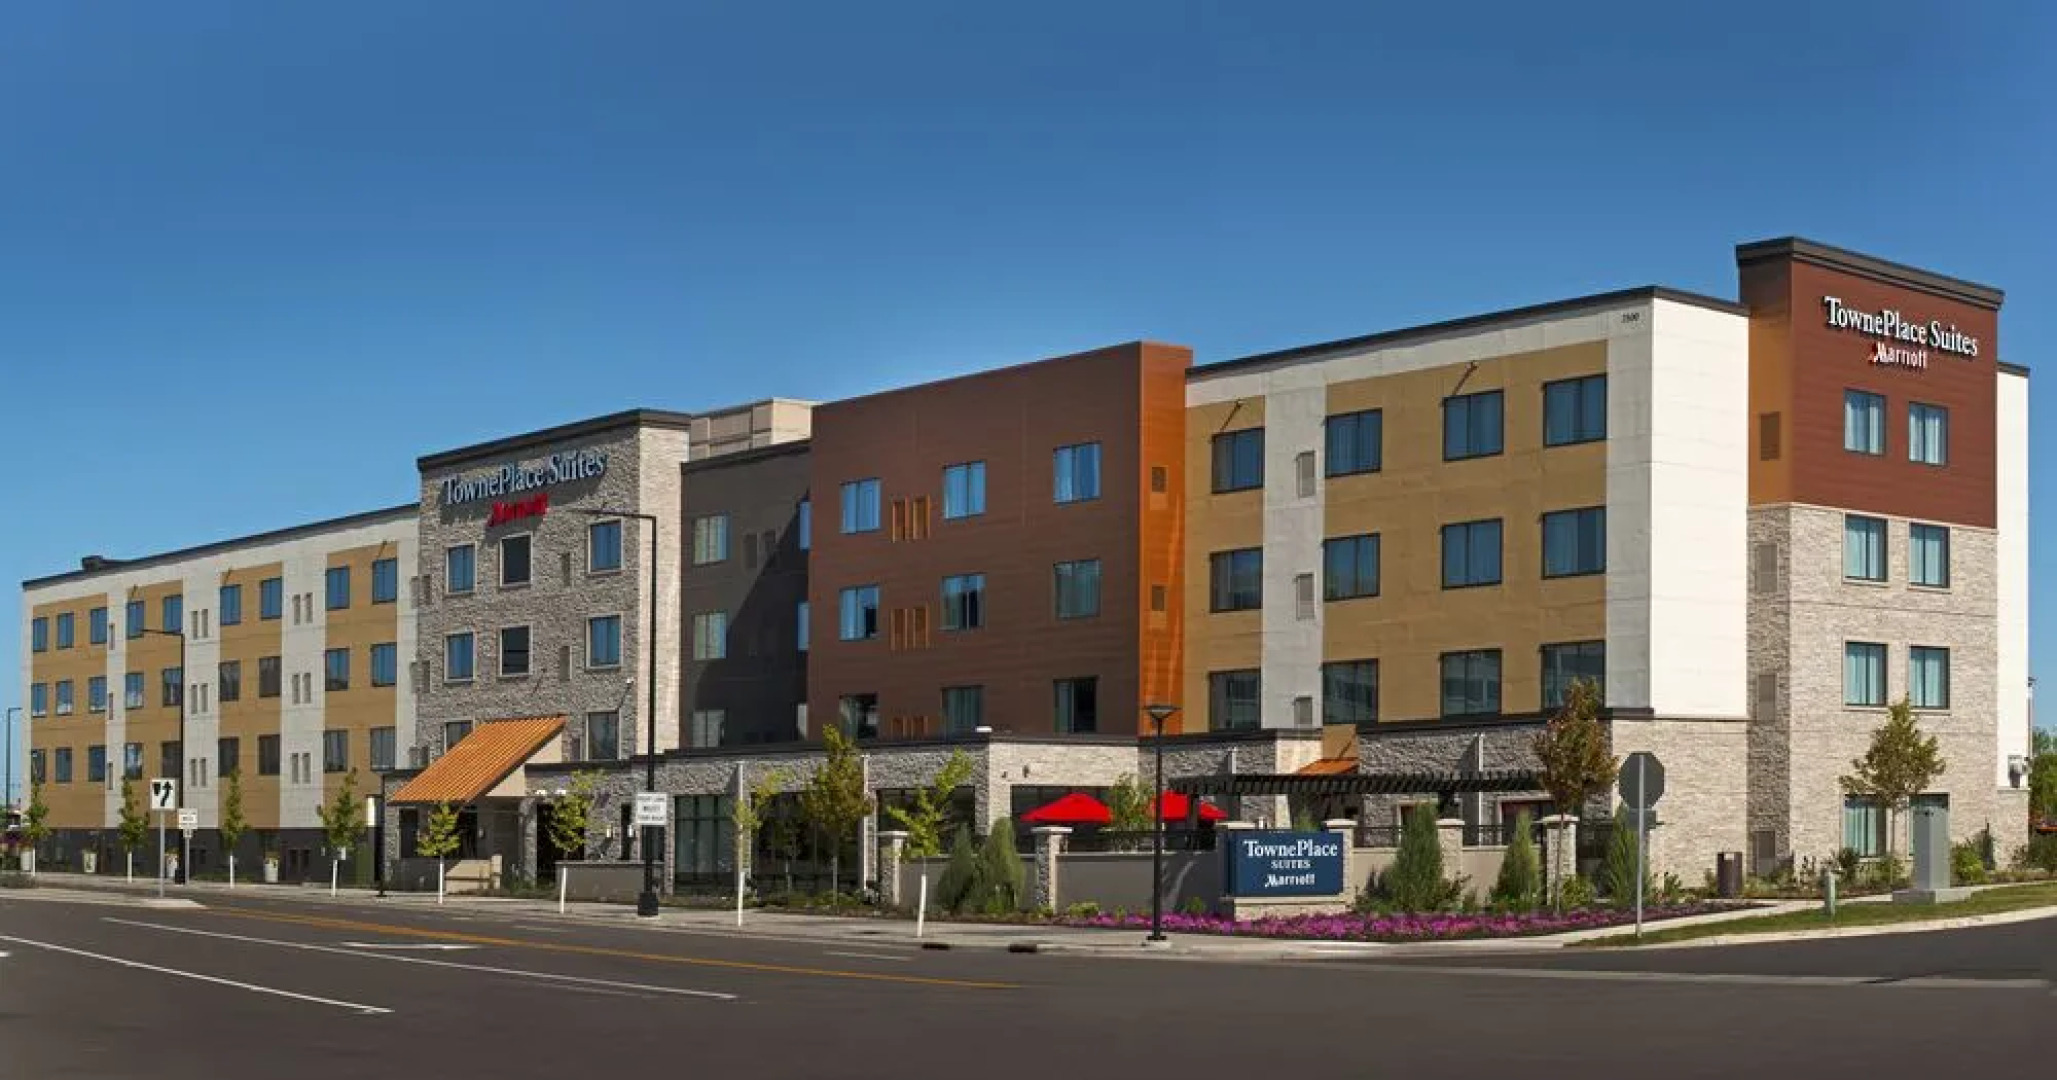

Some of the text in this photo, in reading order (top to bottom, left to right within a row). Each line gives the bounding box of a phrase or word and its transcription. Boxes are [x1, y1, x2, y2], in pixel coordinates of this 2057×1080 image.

[1824, 296, 1978, 357] TownePlace Suites
[1869, 341, 1927, 369] Marriott
[443, 450, 608, 505] TownePlace Suites
[1243, 839, 1338, 858] TownePlace
[1271, 859, 1311, 869] SUITES
[1264, 873, 1315, 888] Marriott
